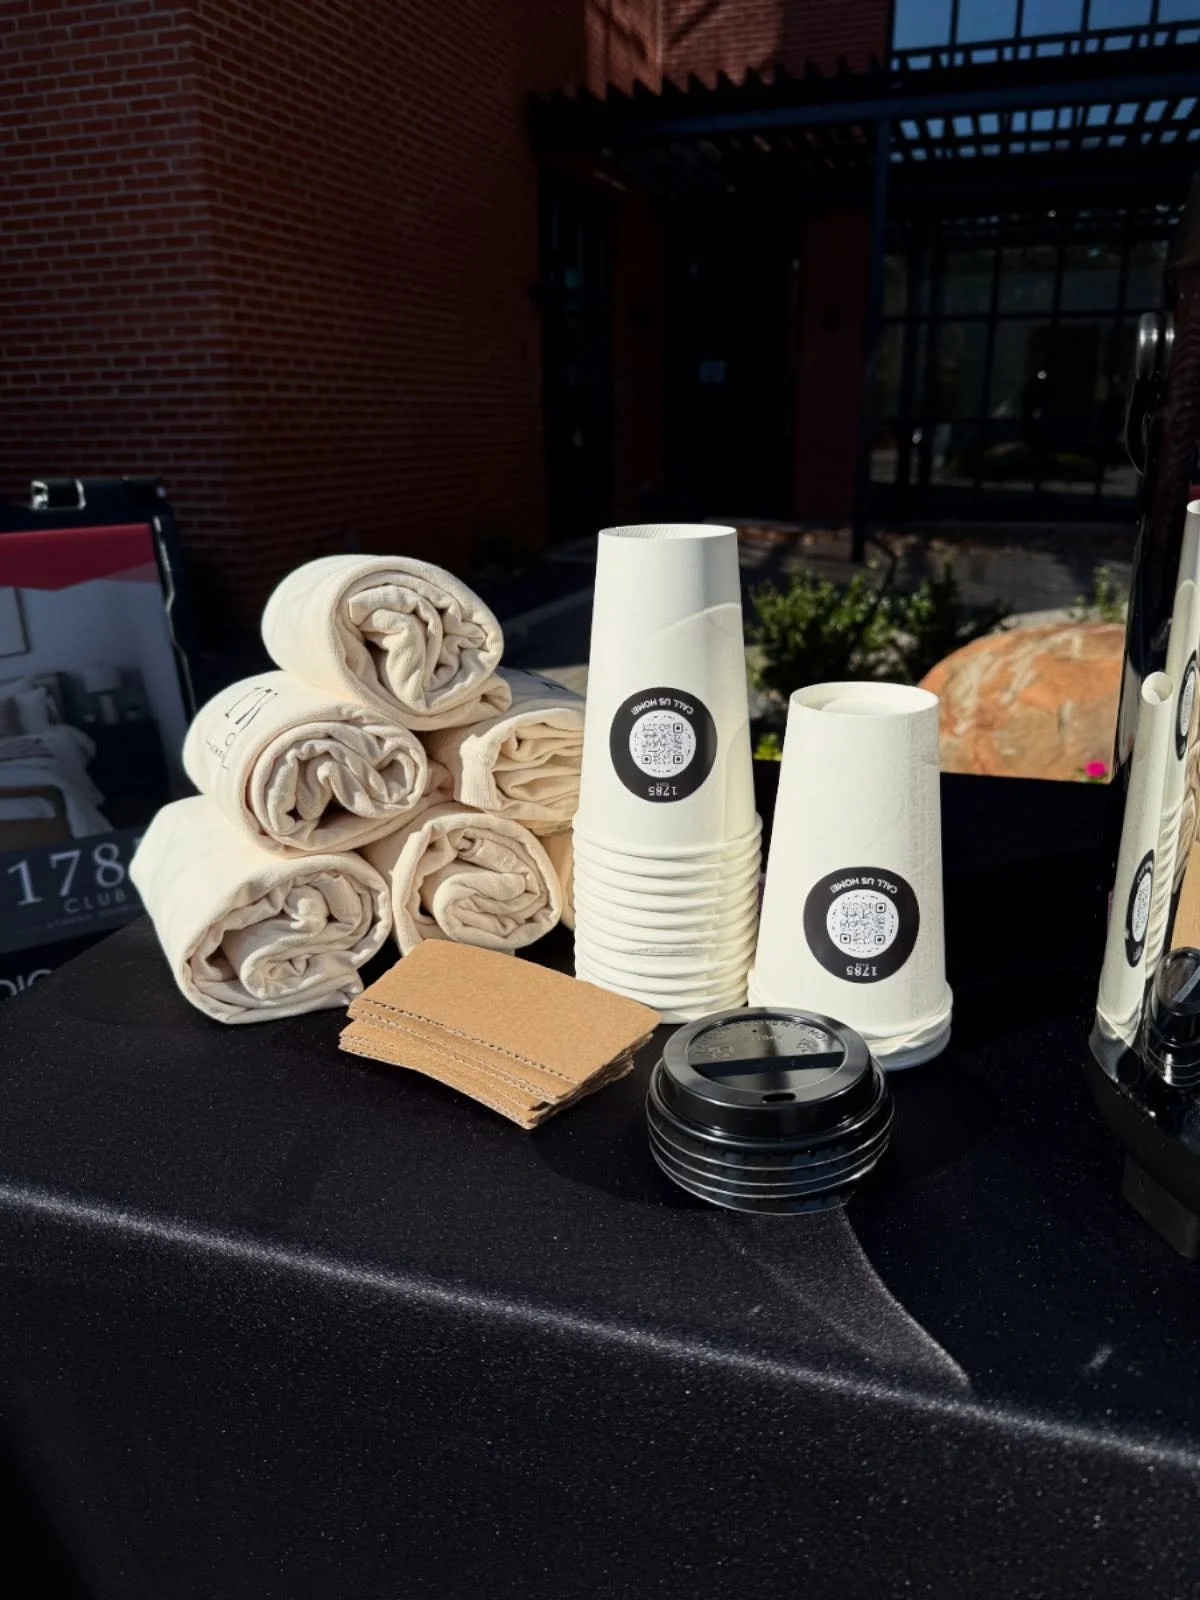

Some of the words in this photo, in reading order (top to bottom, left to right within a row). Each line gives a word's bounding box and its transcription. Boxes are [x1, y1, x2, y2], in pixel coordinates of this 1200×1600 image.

[659, 697, 672, 706] US
[673, 699, 694, 715] CALL
[648, 786, 678, 797] 1785
[7, 838, 143, 906] 178
[861, 877, 875, 885] US
[877, 879, 898, 894] CALL
[64, 888, 127, 914] CLUB
[846, 966, 878, 977] 1785
